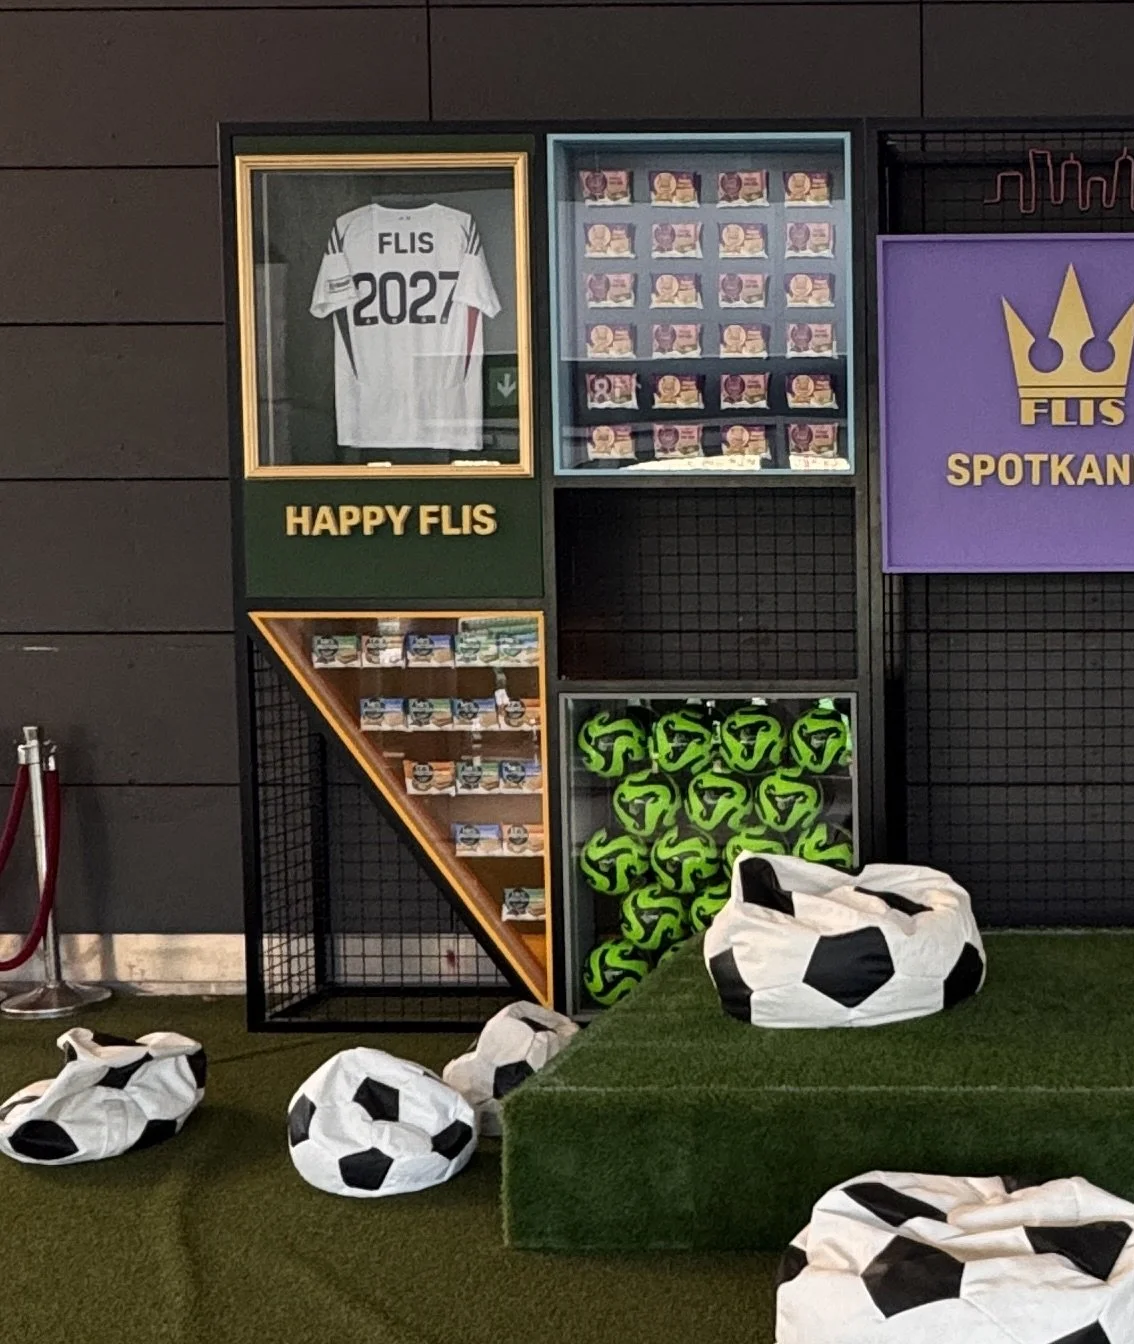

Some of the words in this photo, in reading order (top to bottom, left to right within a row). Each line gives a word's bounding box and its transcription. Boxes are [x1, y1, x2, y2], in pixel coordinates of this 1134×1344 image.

[378, 232, 434, 254] FLIS
[353, 270, 461, 326] 2027
[1019, 398, 1127, 426] FLIS
[285, 504, 411, 536] HAPPY
[419, 504, 498, 536] FLIS
